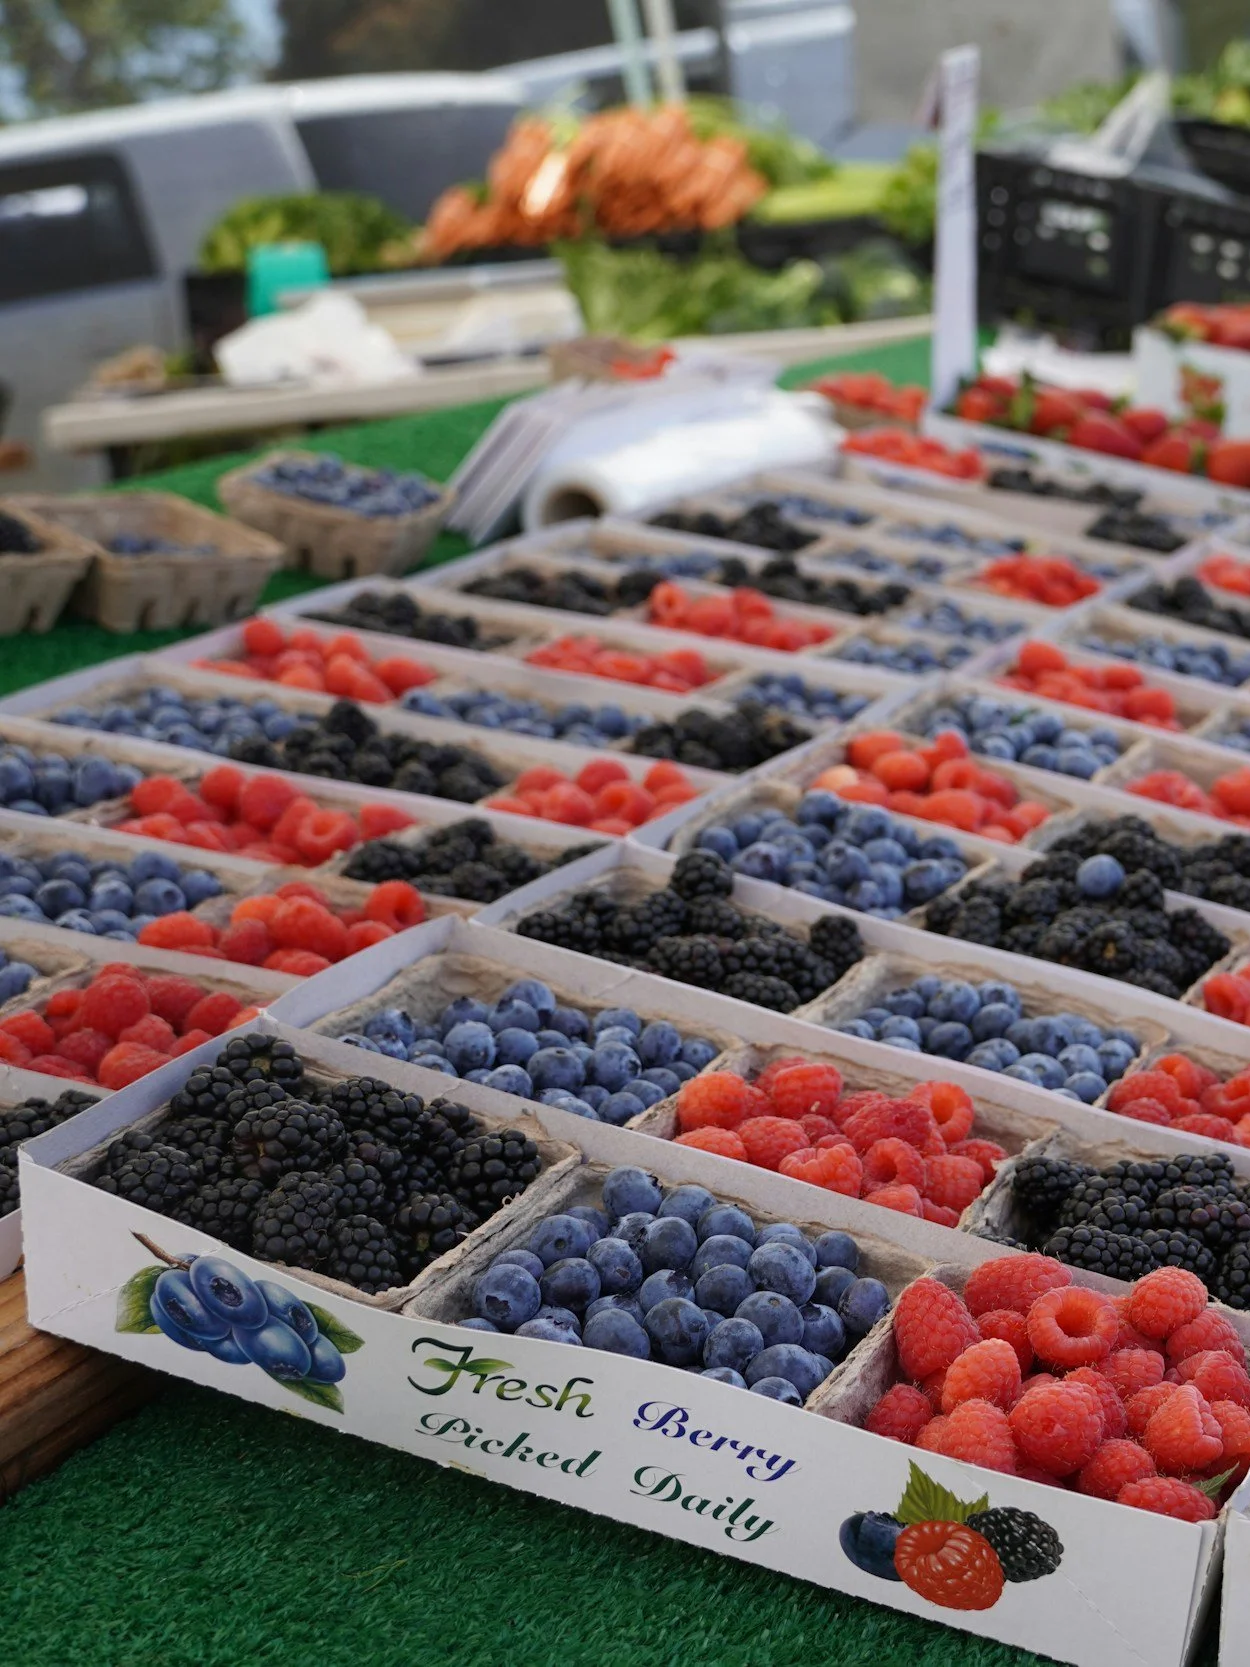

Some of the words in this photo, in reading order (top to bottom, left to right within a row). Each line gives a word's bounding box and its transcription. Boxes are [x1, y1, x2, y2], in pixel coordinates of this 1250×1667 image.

[408, 1337, 595, 1418] Fresh
[632, 1401, 801, 1482] Berry
[415, 1412, 602, 1479] Picked
[630, 1466, 780, 1542] Daily
